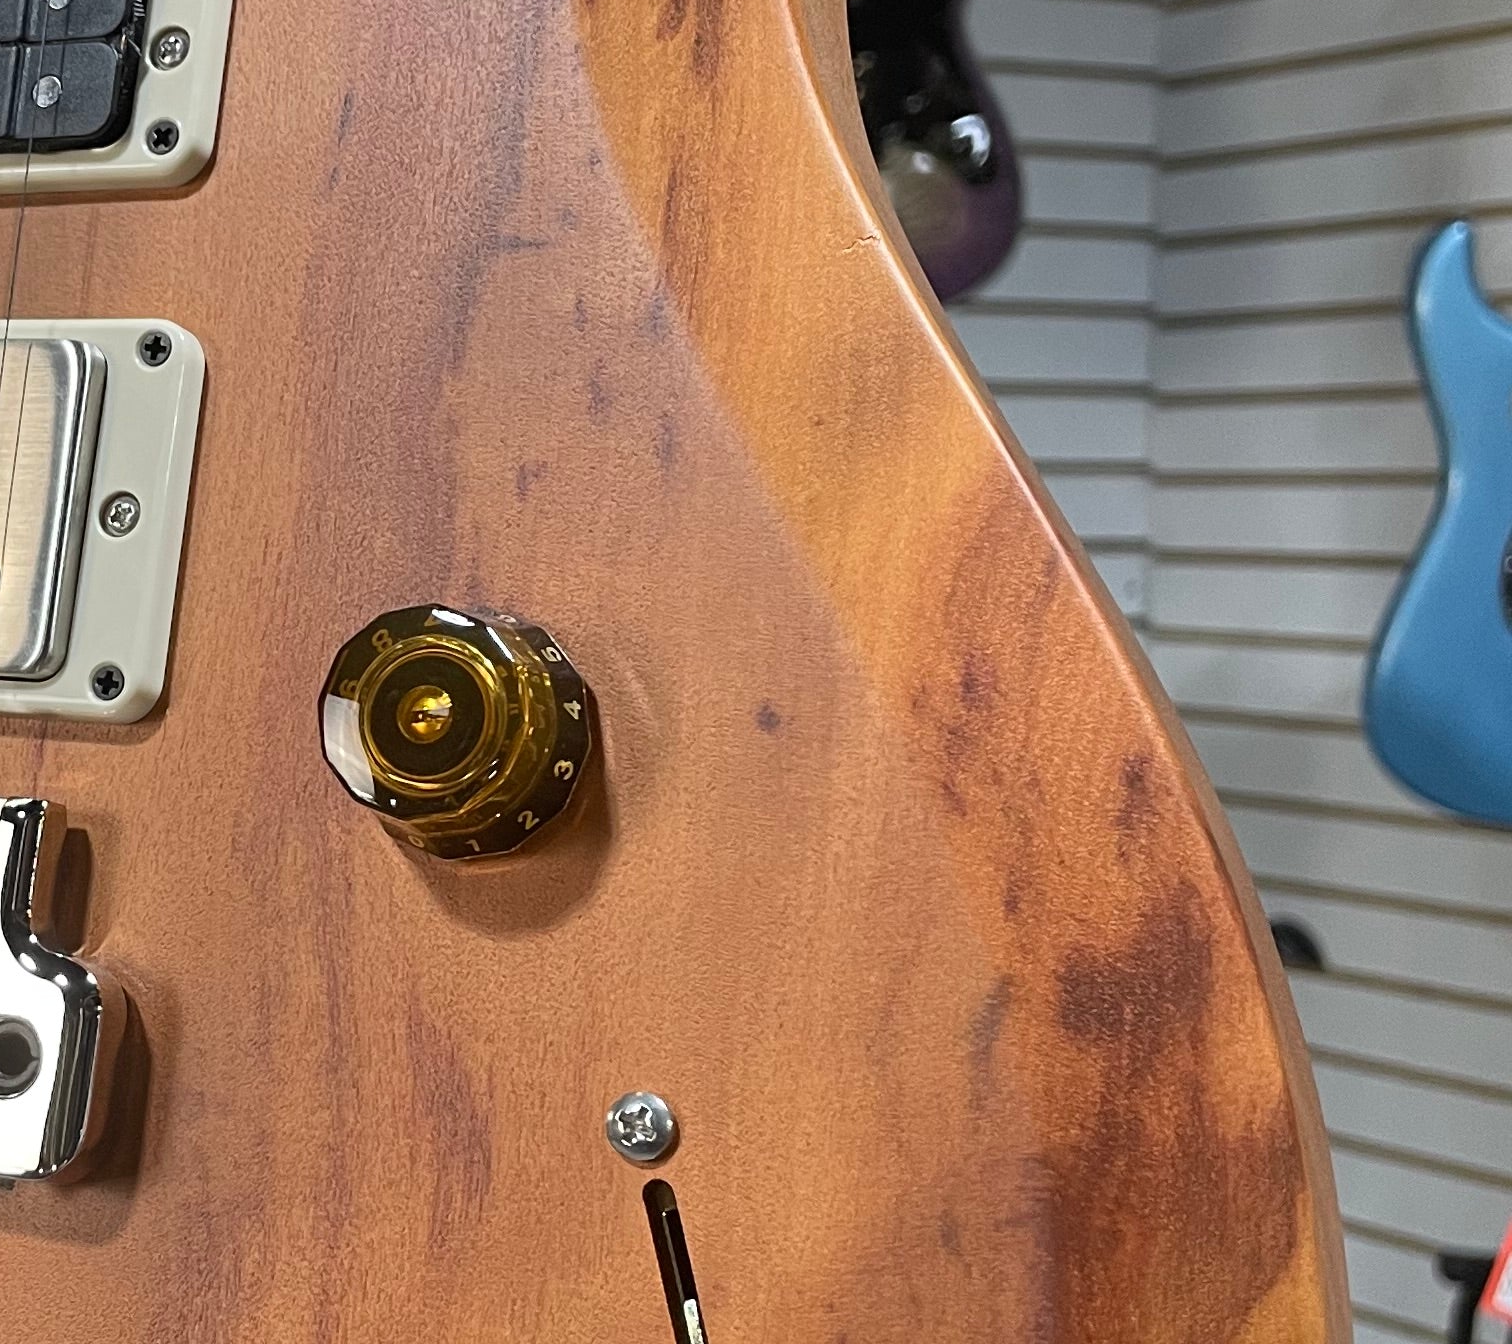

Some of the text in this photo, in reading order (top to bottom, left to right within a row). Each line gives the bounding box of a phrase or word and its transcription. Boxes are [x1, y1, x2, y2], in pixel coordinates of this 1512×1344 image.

[541, 646, 563, 663] 5
[563, 700, 581, 720] 4
[554, 759, 574, 780] 3
[517, 810, 540, 830] 2
[465, 839, 481, 852] 1
